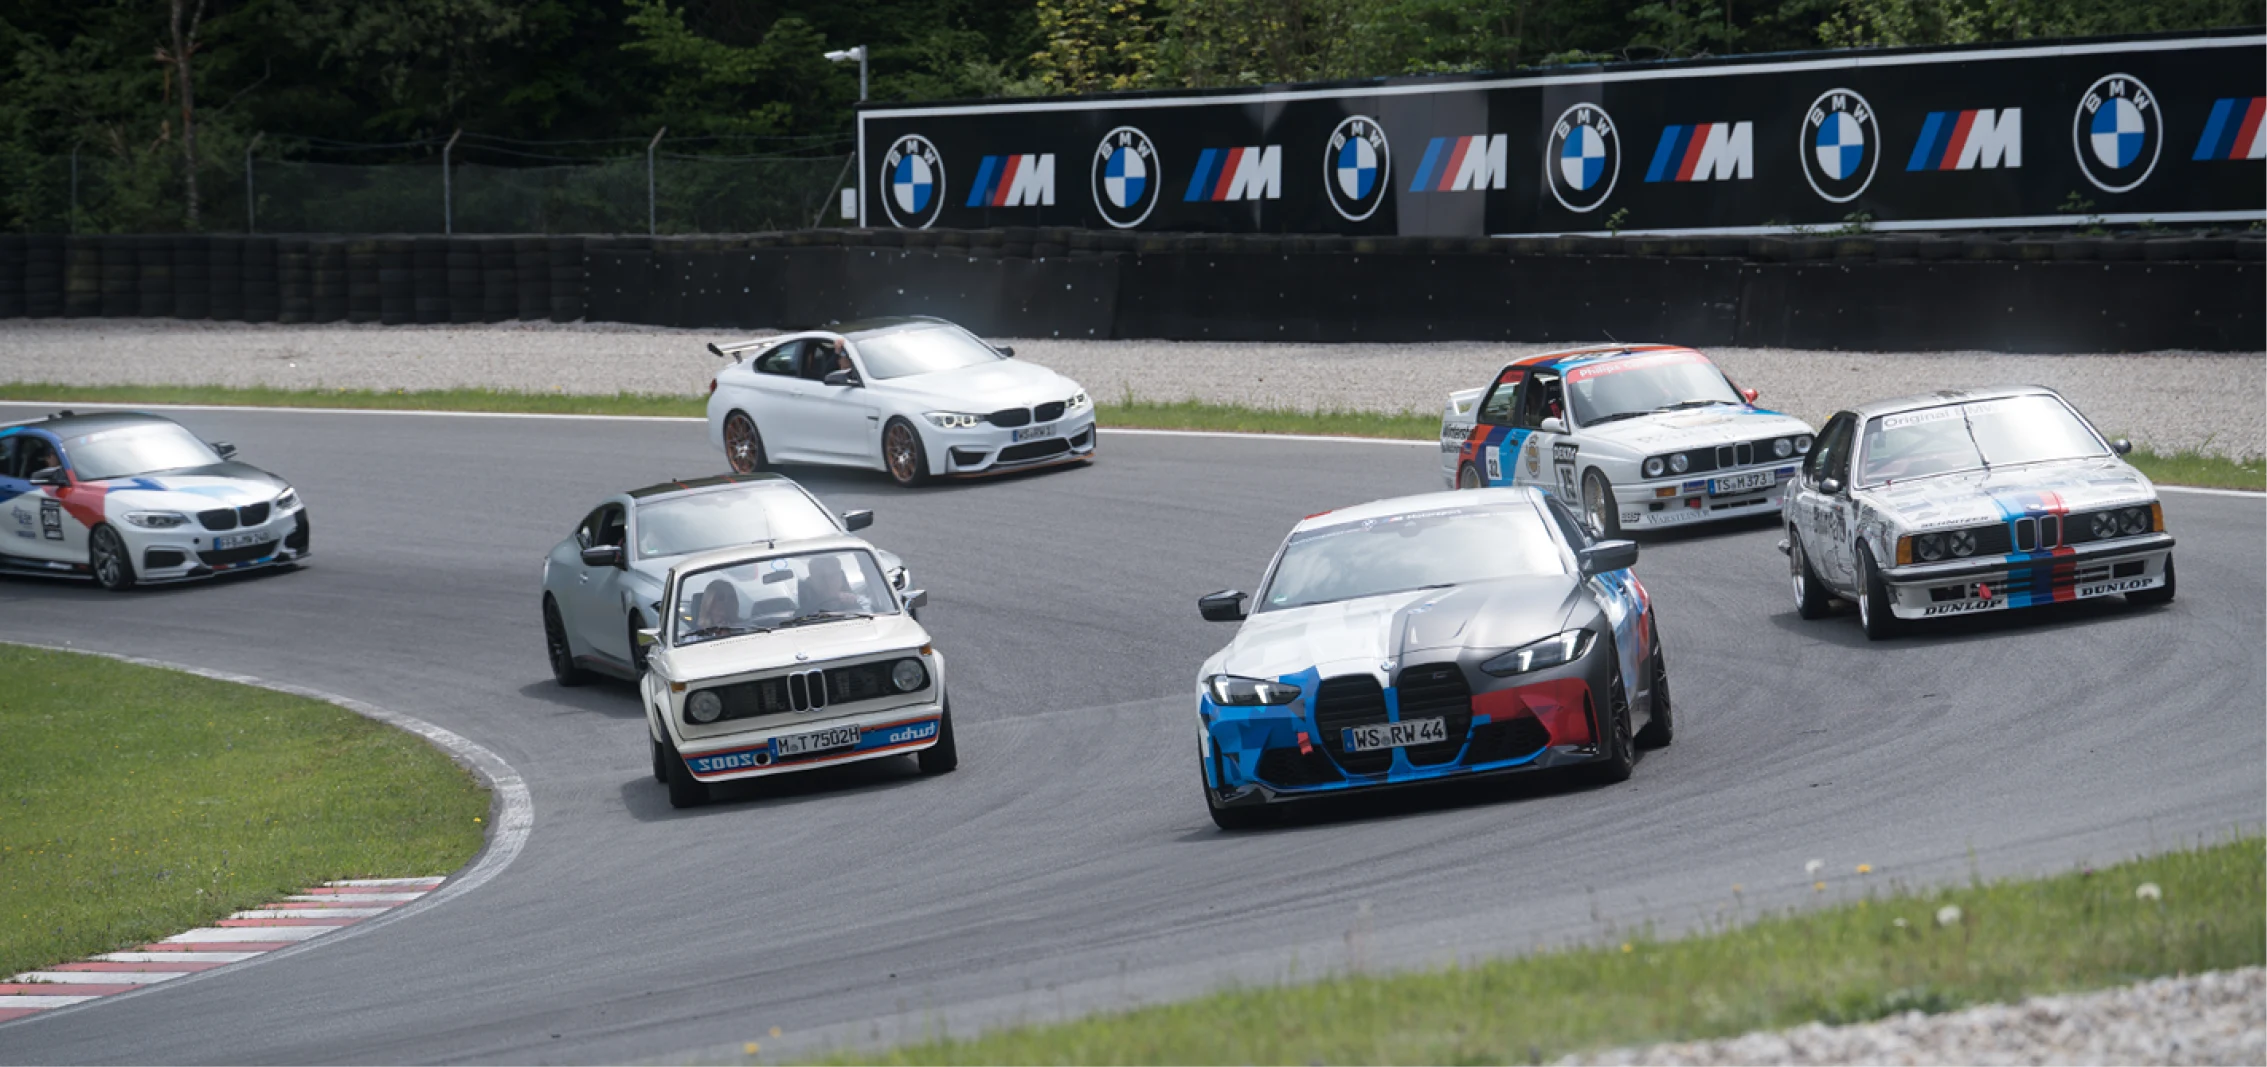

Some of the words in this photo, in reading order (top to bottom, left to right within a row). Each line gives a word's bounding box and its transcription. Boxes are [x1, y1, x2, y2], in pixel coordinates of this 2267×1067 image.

[1810, 95, 1868, 127] BMW
[2085, 80, 2150, 113] BMW
[1332, 121, 1384, 152] BMW
[1557, 108, 1611, 138] BMW
[1955, 107, 2021, 169] M
[889, 138, 937, 168] BMW
[1101, 132, 1151, 161] BMW
[1691, 121, 1753, 181] M
[1224, 145, 1281, 200] M
[1448, 133, 1507, 191] M
[1003, 153, 1055, 206] M
[1884, 410, 1950, 427] Original
[1716, 479, 1730, 492] TS
[1748, 474, 1768, 488] 373
[2081, 578, 2153, 597] DUNLOP
[1923, 600, 2003, 616] DUNLOP
[778, 738, 790, 753] M
[799, 735, 808, 751] T
[811, 727, 861, 749] 7502H
[1354, 729, 1380, 748] WS
[1390, 725, 1415, 744] RW
[1420, 721, 1444, 740] 44
